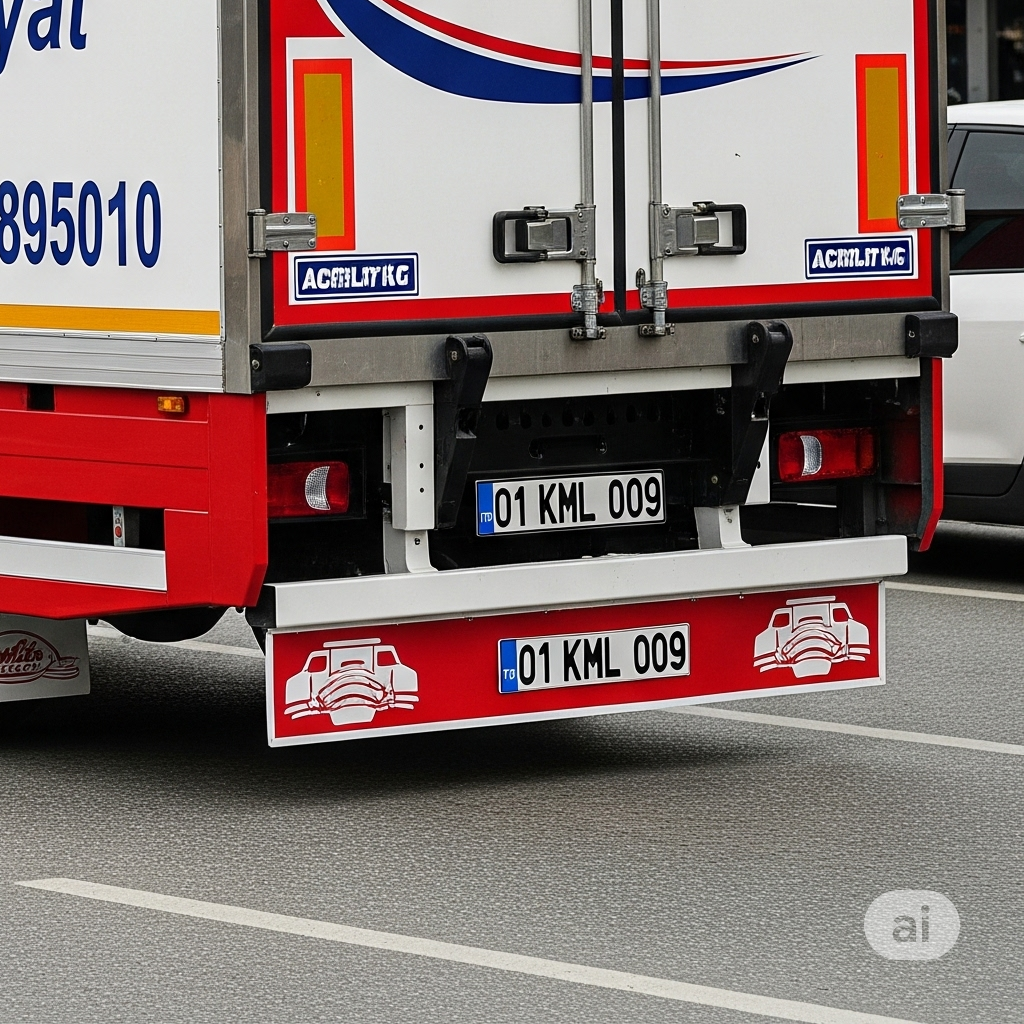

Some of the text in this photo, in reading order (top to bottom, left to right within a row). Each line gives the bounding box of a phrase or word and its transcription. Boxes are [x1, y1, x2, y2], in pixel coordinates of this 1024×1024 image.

[494, 486, 526, 528] 01
[538, 481, 596, 525] KML
[608, 476, 661, 519] 009
[518, 641, 550, 686] 01
[563, 636, 621, 682] KML
[633, 630, 686, 675] 009
